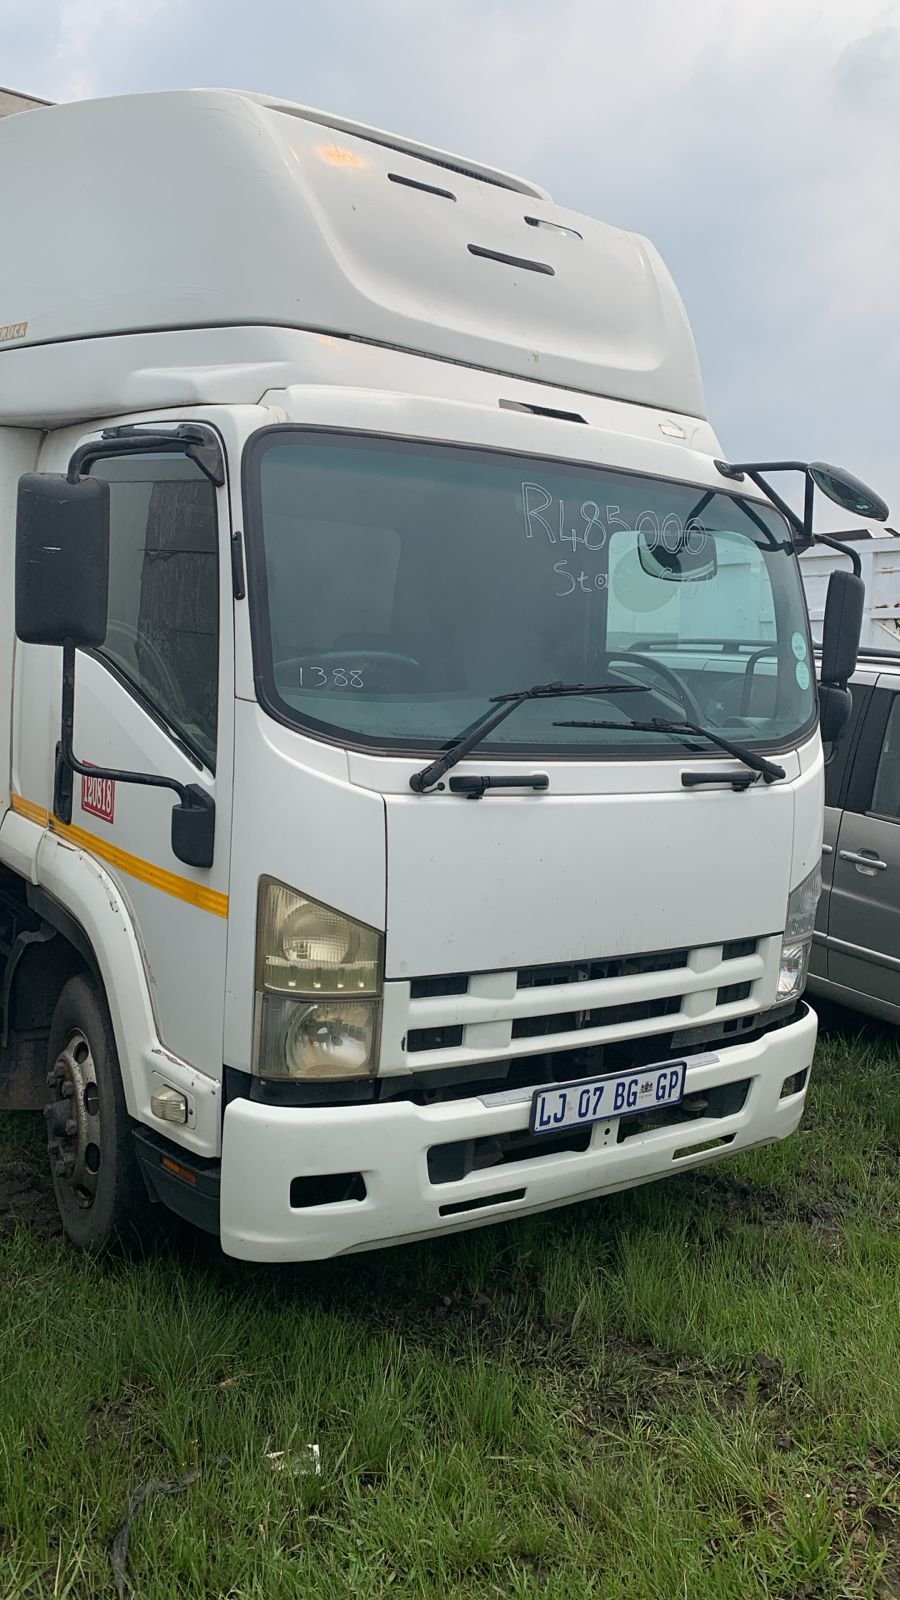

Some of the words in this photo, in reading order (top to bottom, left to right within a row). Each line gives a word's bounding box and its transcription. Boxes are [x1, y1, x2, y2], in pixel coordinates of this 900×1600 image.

[0, 323, 27, 340] RUCK
[299, 666, 364, 688] 1388
[83, 775, 113, 814] 120818
[539, 1093, 567, 1127] LJ
[578, 1086, 605, 1119] 07
[613, 1079, 639, 1111] BG
[655, 1070, 679, 1101] GP
